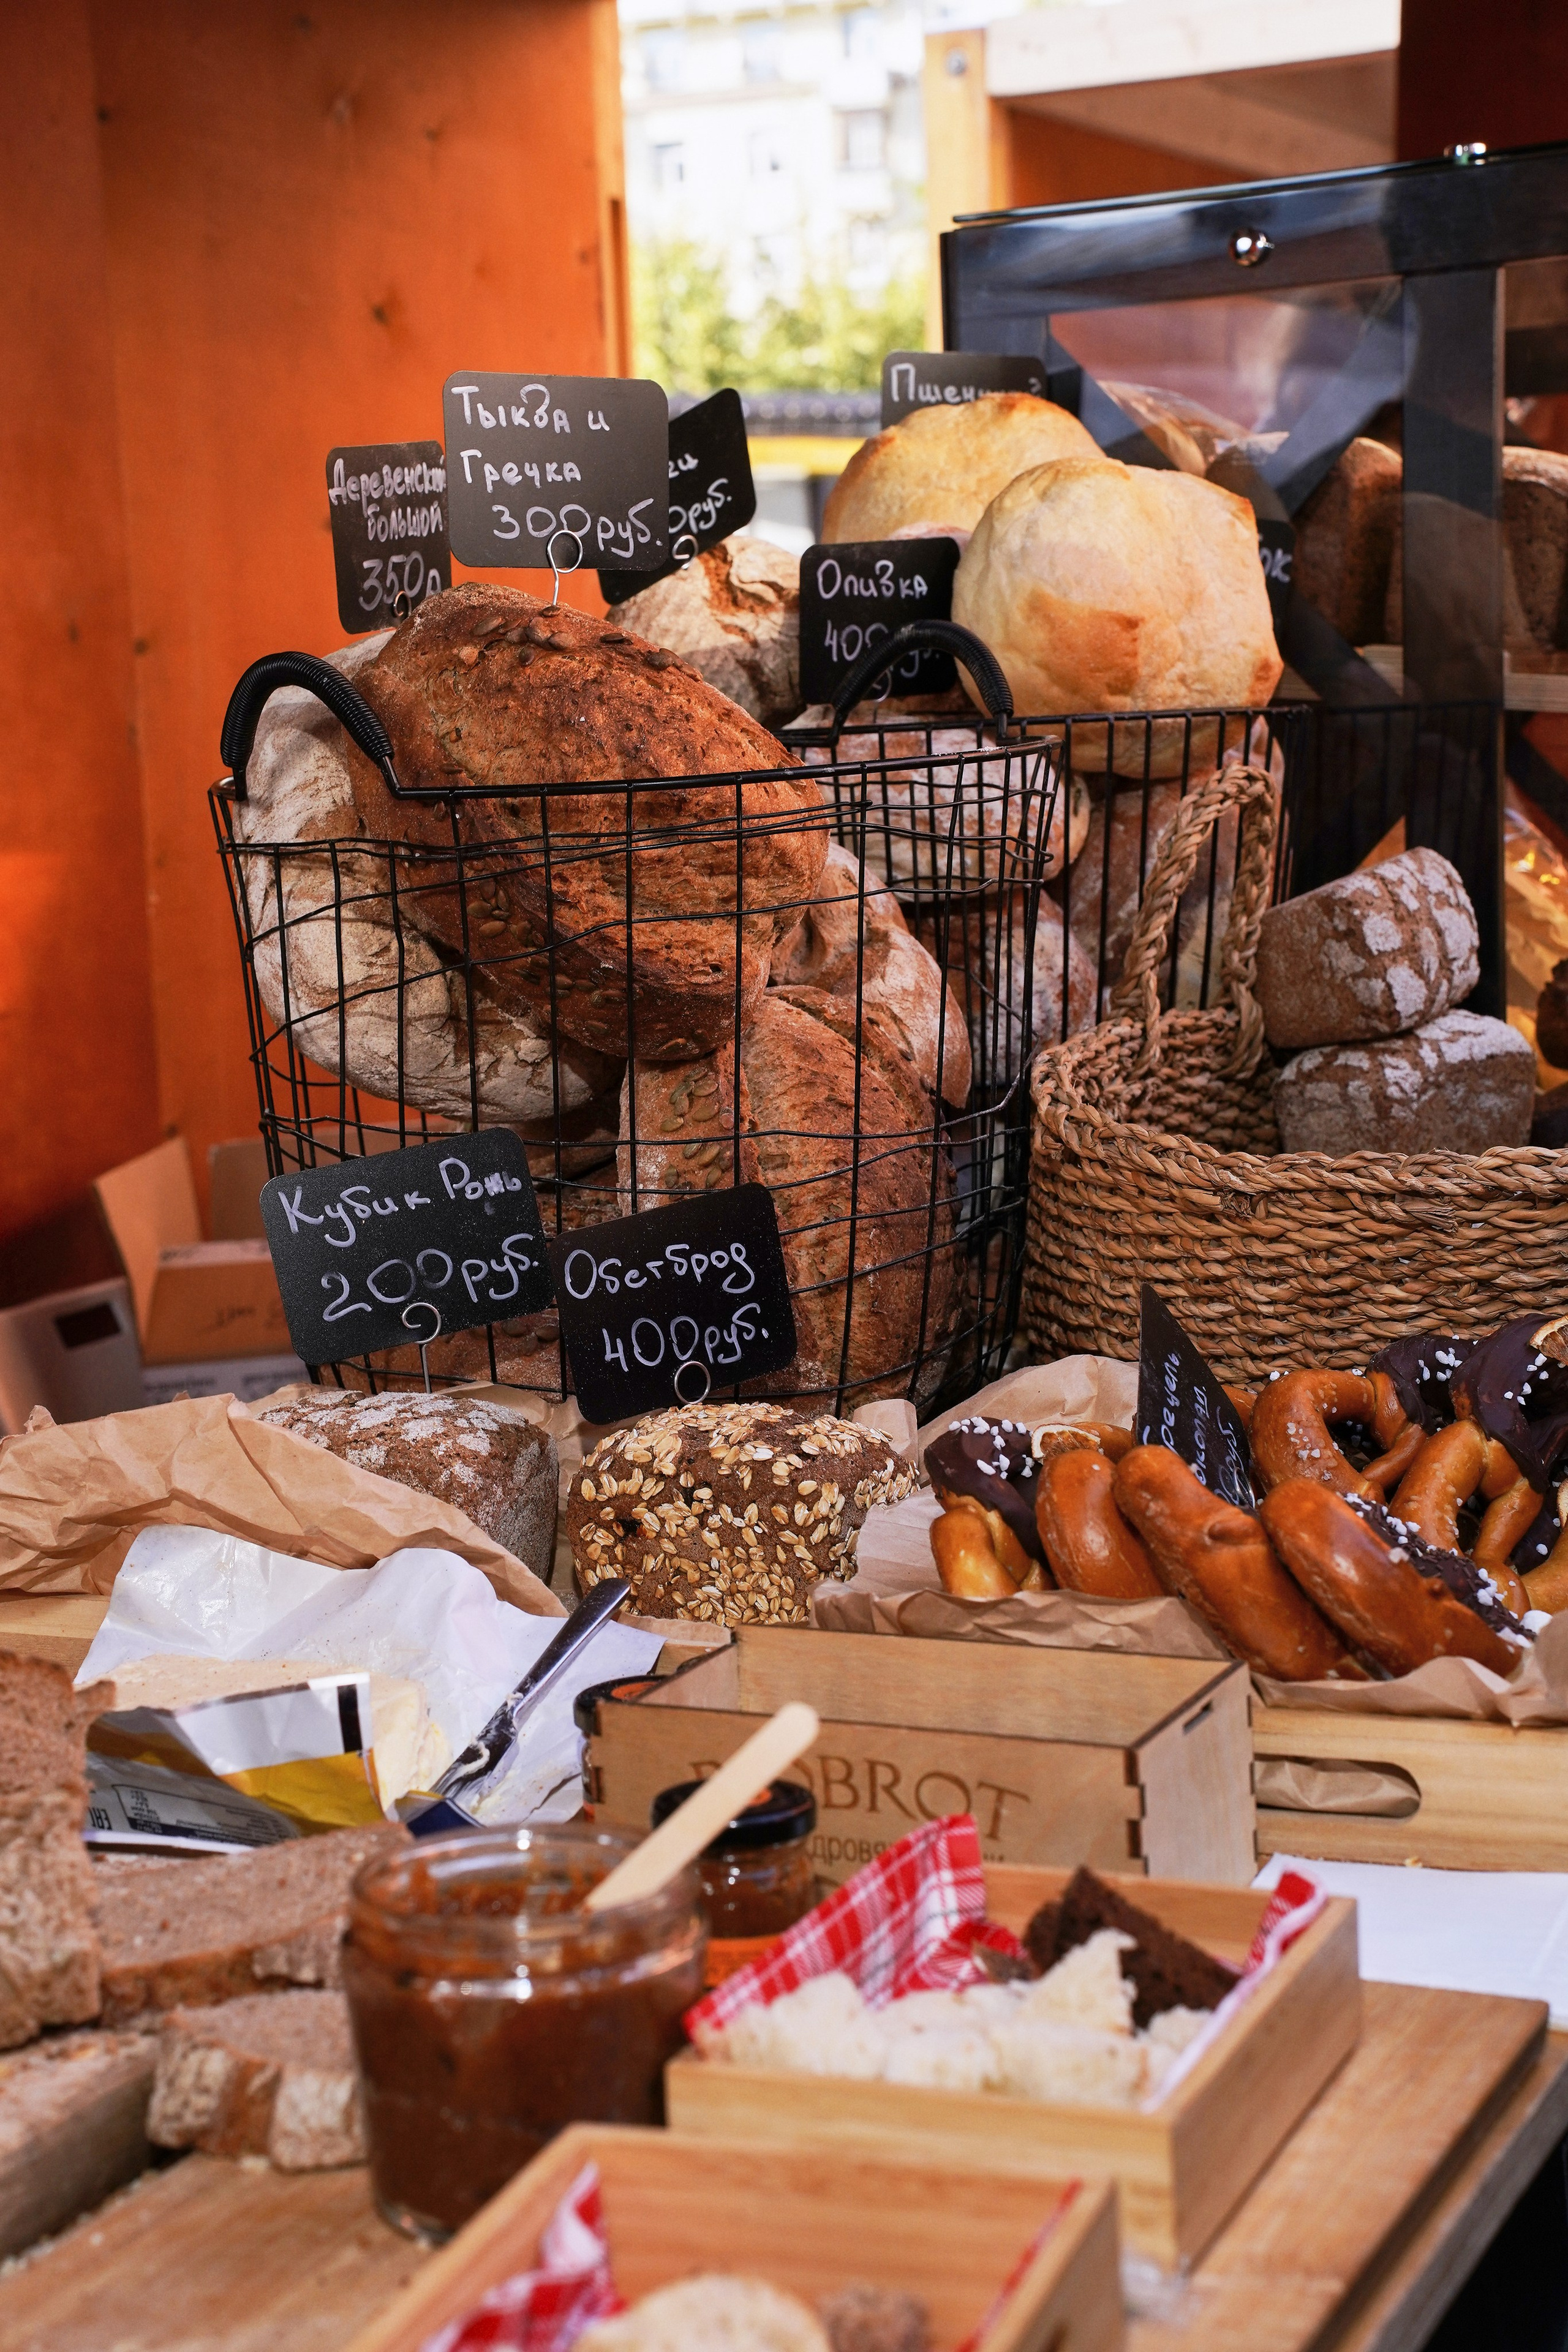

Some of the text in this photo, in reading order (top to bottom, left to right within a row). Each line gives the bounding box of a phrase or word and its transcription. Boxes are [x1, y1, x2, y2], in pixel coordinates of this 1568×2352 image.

[451, 383, 610, 434] Тыква и
[459, 448, 581, 493] Гречка
[277, 1185, 430, 1248] Кубик
[602, 1302, 770, 1373] 400руб.
